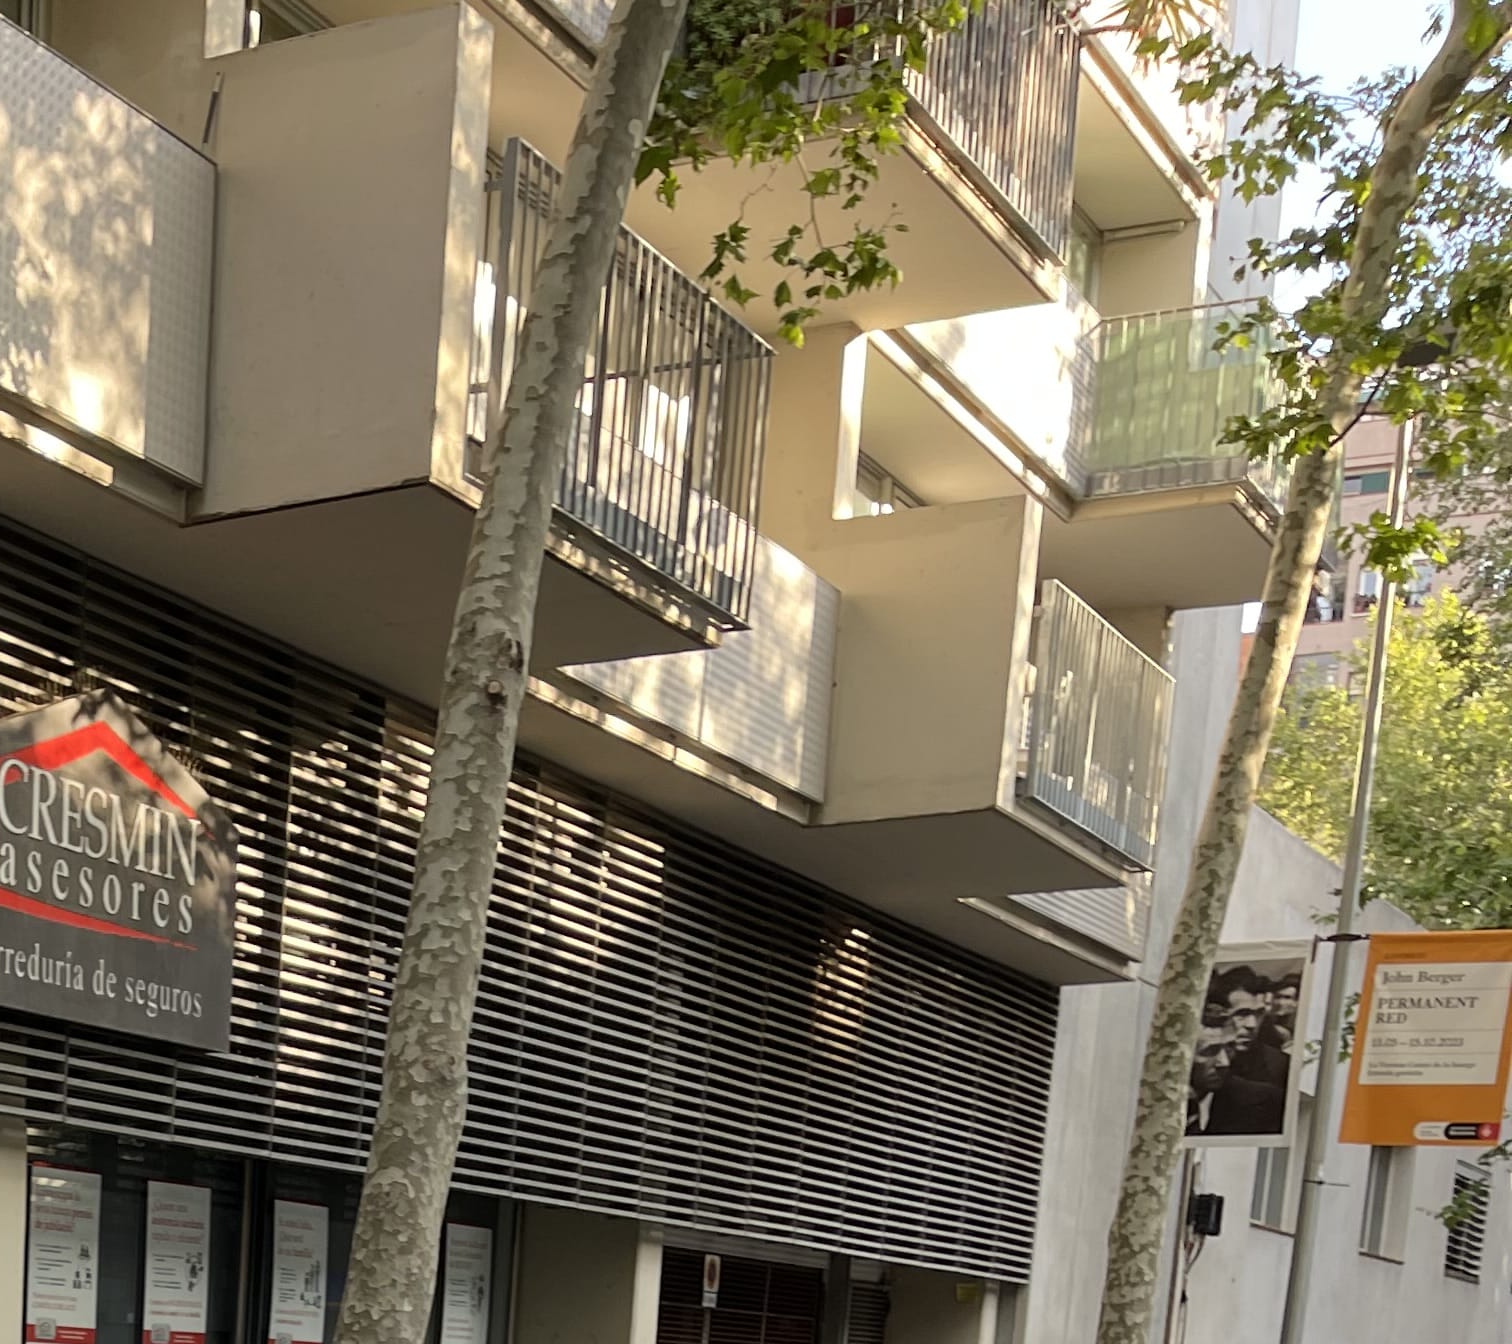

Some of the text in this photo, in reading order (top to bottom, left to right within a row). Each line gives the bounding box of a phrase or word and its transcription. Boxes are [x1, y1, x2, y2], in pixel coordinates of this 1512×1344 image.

[1382, 970, 1467, 985] John Berger
[92, 958, 117, 999] de
[123, 974, 203, 1019] seguros
[1377, 996, 1480, 1010] PERMANENT
[1375, 1011, 1408, 1025] RED
